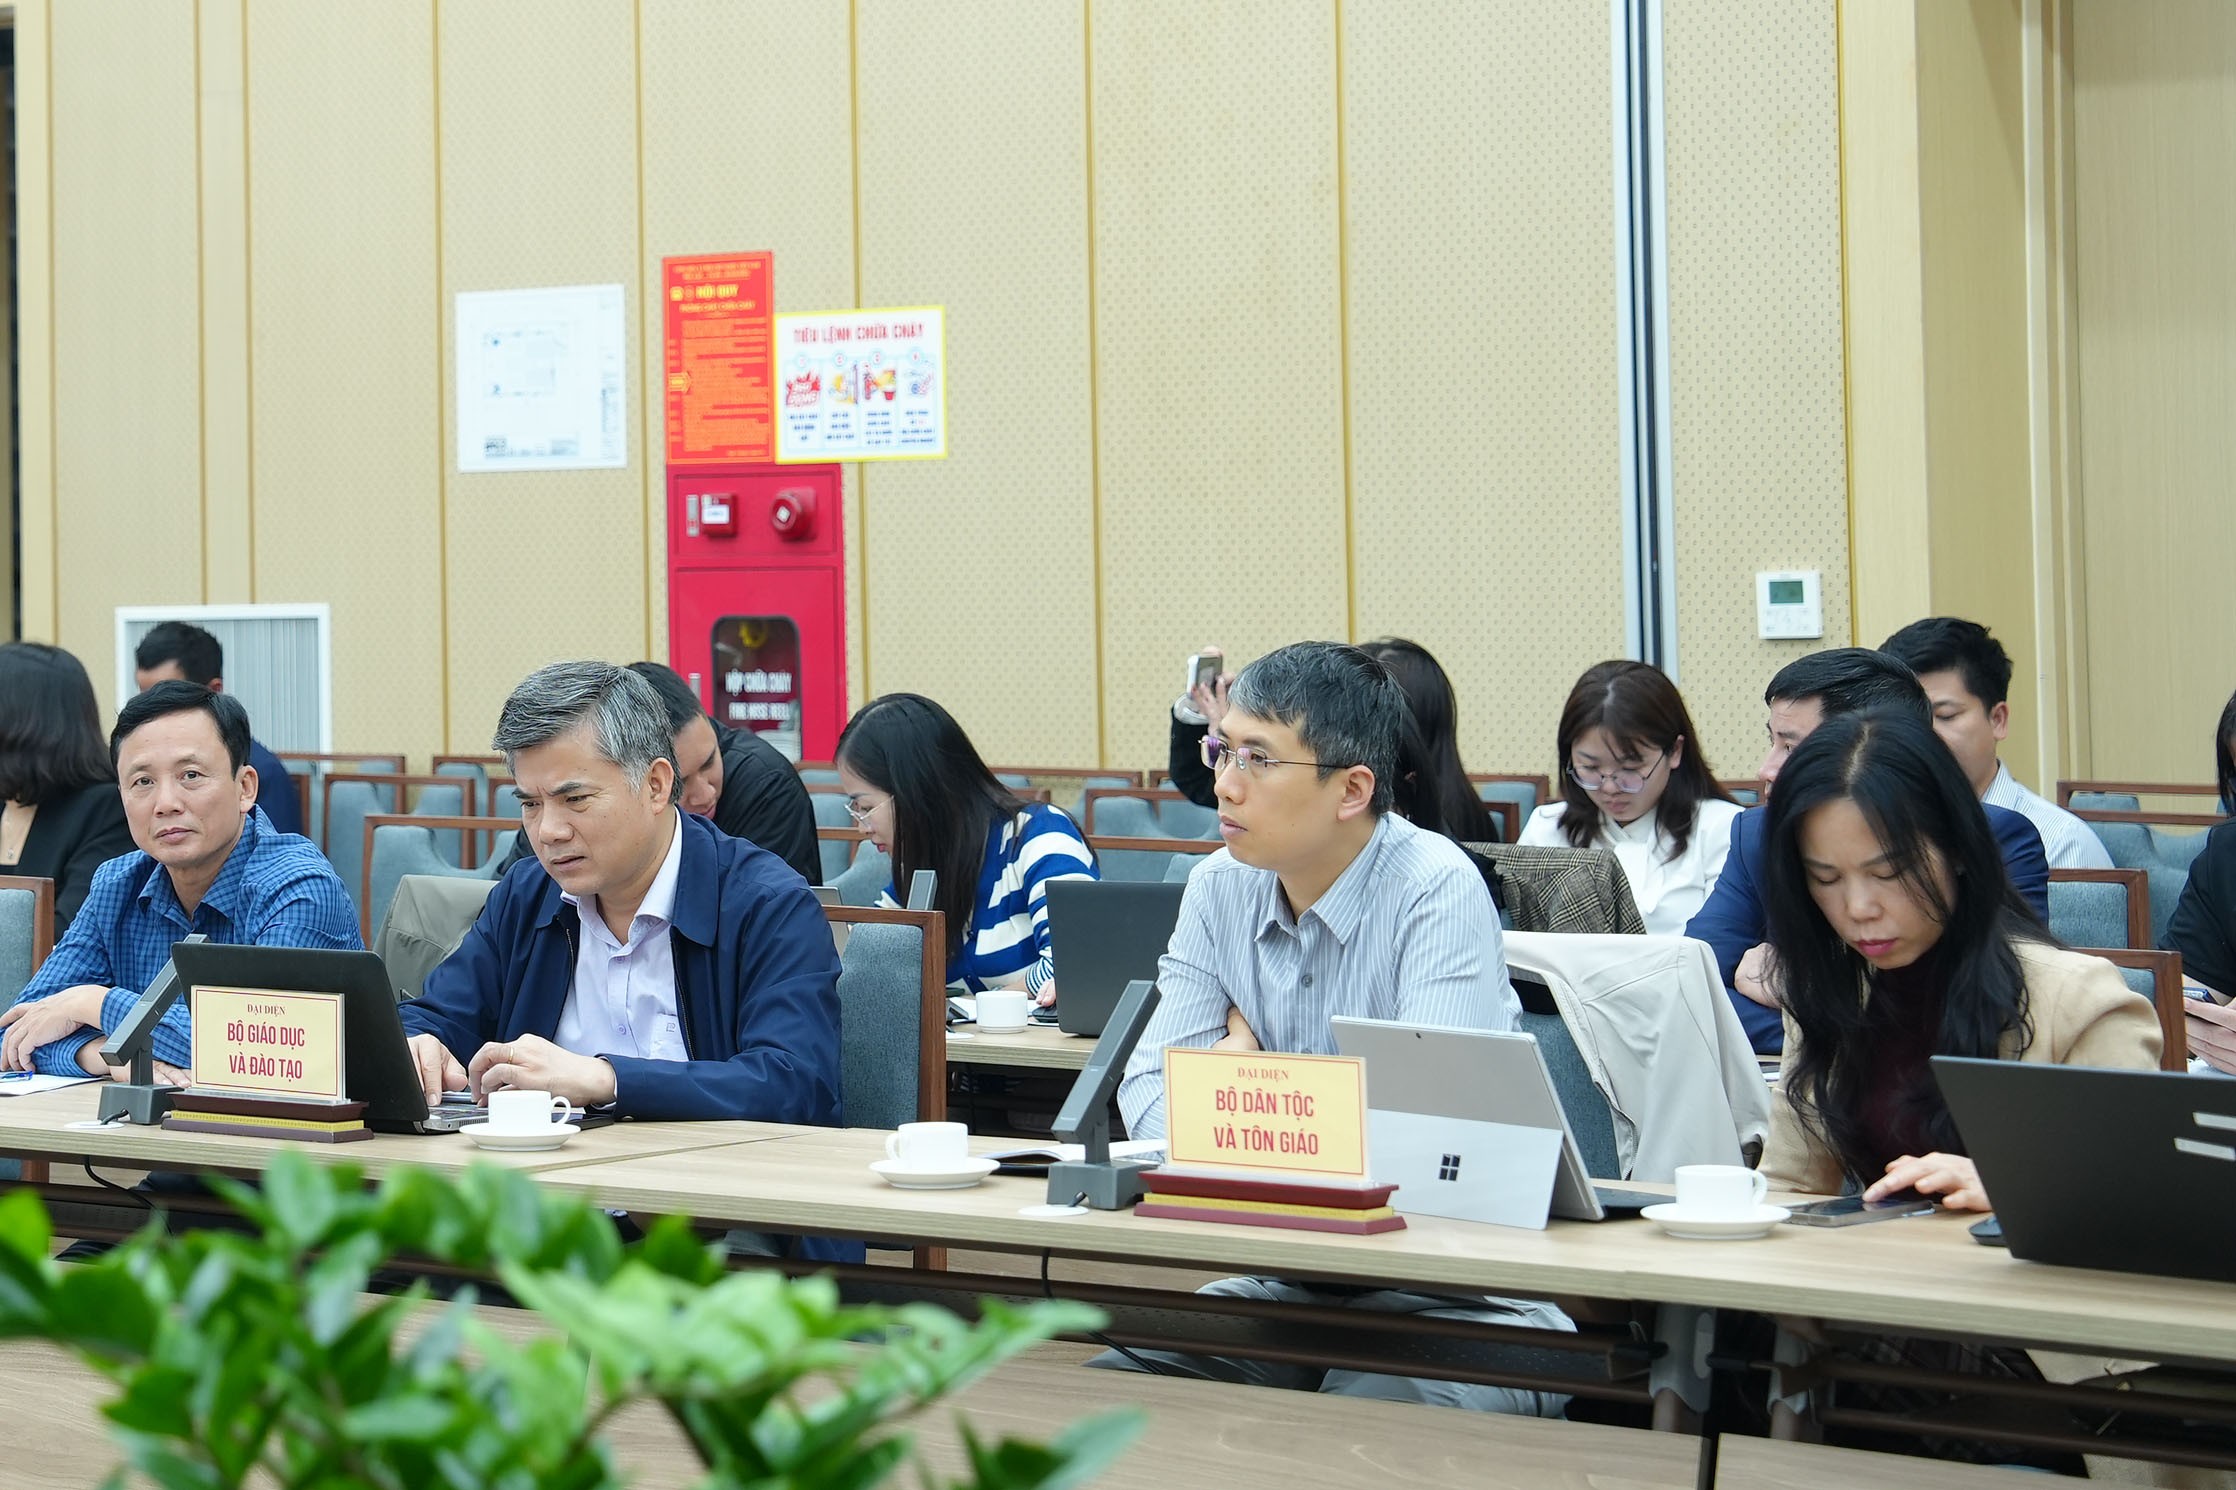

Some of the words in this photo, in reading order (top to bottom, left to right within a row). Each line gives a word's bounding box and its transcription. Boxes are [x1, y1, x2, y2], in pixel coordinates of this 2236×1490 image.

[247, 1004, 262, 1015] ĐẠI
[264, 1005, 286, 1017] DIỆN
[227, 1020, 244, 1046] BỘ
[248, 1021, 276, 1045] GIÁO
[280, 1026, 305, 1050] DỤC
[229, 1051, 246, 1074] VÀ
[249, 1053, 275, 1077] ĐÀO
[278, 1058, 303, 1082] TẠO
[1237, 1067, 1257, 1080] ĐẠI
[1261, 1068, 1289, 1082] DIỆN
[1216, 1086, 1237, 1116] BỘ
[1243, 1088, 1277, 1115] DÂN
[1281, 1090, 1314, 1121] TỘC
[1213, 1122, 1237, 1150] VÀ
[1241, 1125, 1274, 1152] TÔN
[1280, 1128, 1318, 1155] GIÁO
